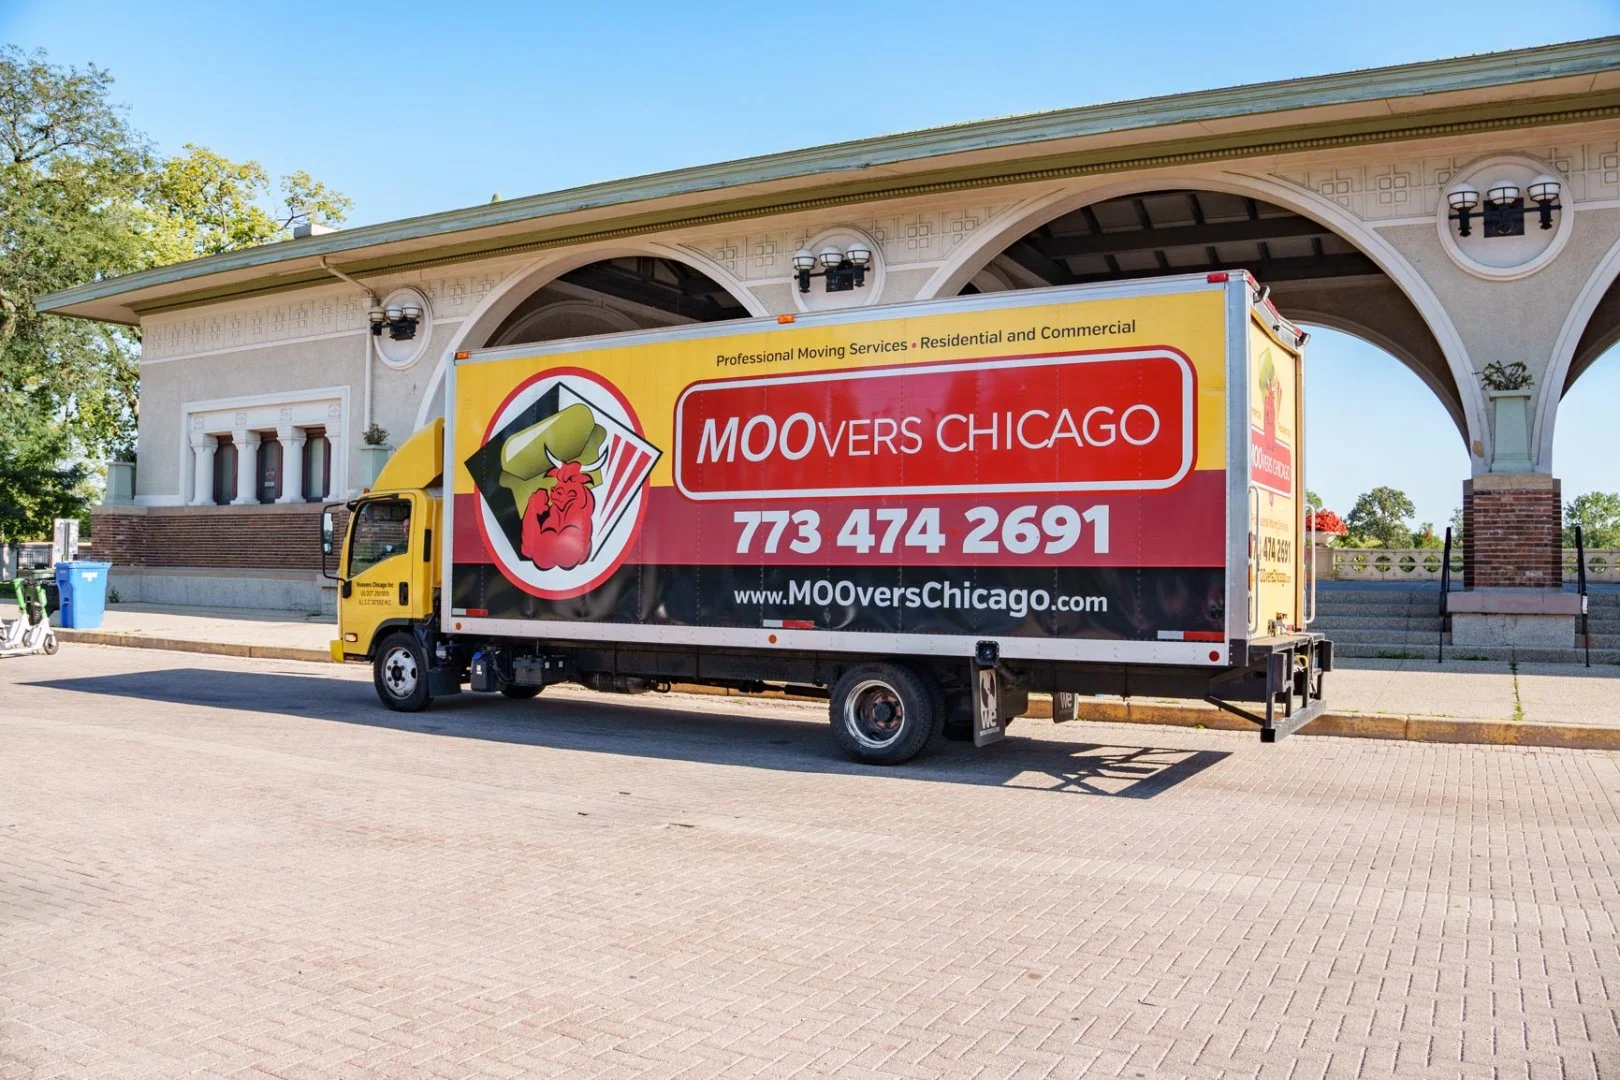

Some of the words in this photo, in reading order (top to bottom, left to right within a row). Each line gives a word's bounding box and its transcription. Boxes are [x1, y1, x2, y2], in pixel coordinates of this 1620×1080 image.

[716, 347, 794, 367] Professional
[797, 345, 846, 360] Moving
[849, 340, 908, 355] Services
[920, 329, 1002, 349] Residential
[1006, 327, 1036, 342] and
[1040, 319, 1136, 340] Commercial
[936, 403, 1161, 453] CHICAGO
[733, 508, 822, 554] 773
[836, 507, 946, 554] 474
[962, 504, 1110, 554] 2691
[1263, 536, 1276, 562] 474
[1276, 538, 1291, 564] 2691
[734, 579, 1108, 618] www.MOOversChicago.com
